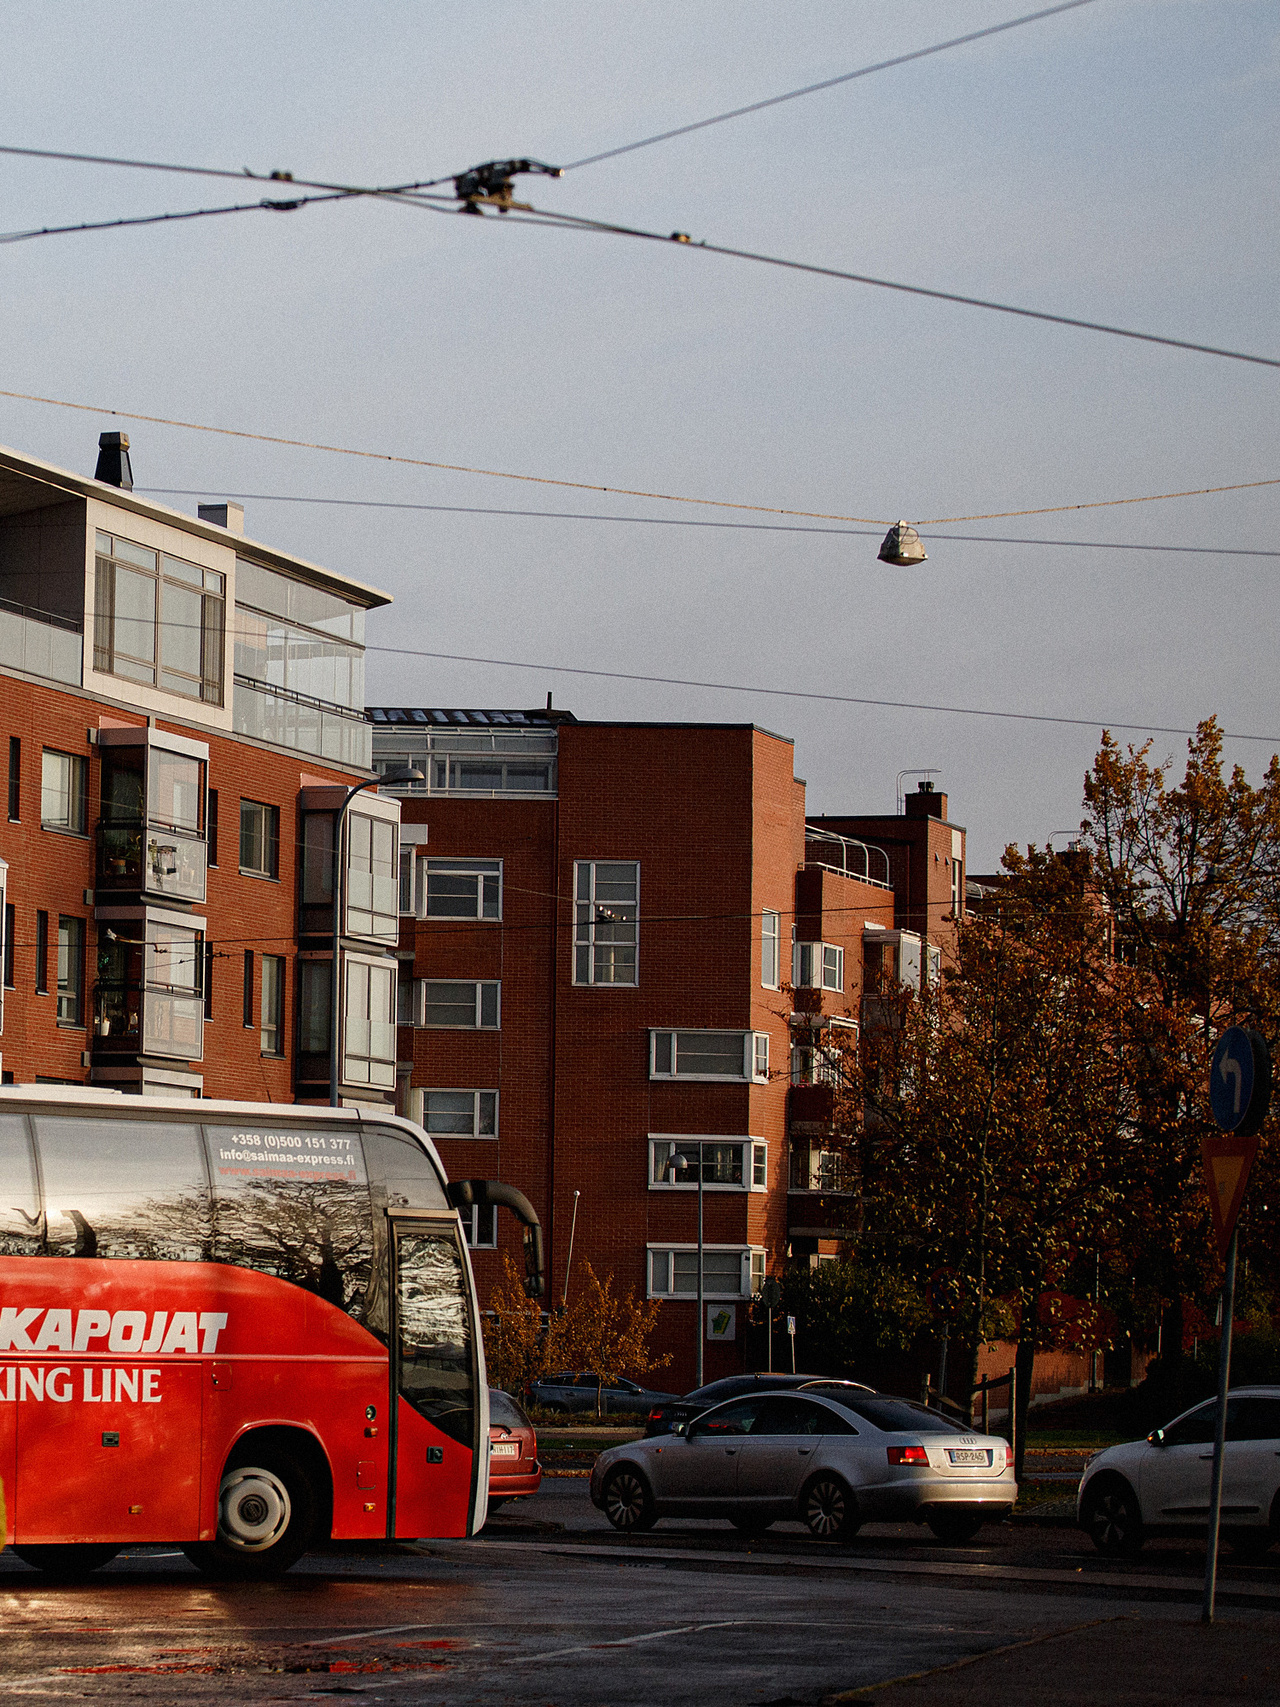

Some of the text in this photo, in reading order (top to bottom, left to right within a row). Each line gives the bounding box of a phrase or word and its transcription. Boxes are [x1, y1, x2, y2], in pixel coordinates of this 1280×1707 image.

[231, 1134, 351, 1150] +358 (0)500 151 377
[220, 1149, 355, 1166] info@saimaa-express.fi
[219, 1167, 357, 1181] www.saimaa-express.fi
[82, 1368, 163, 1403] LINE
